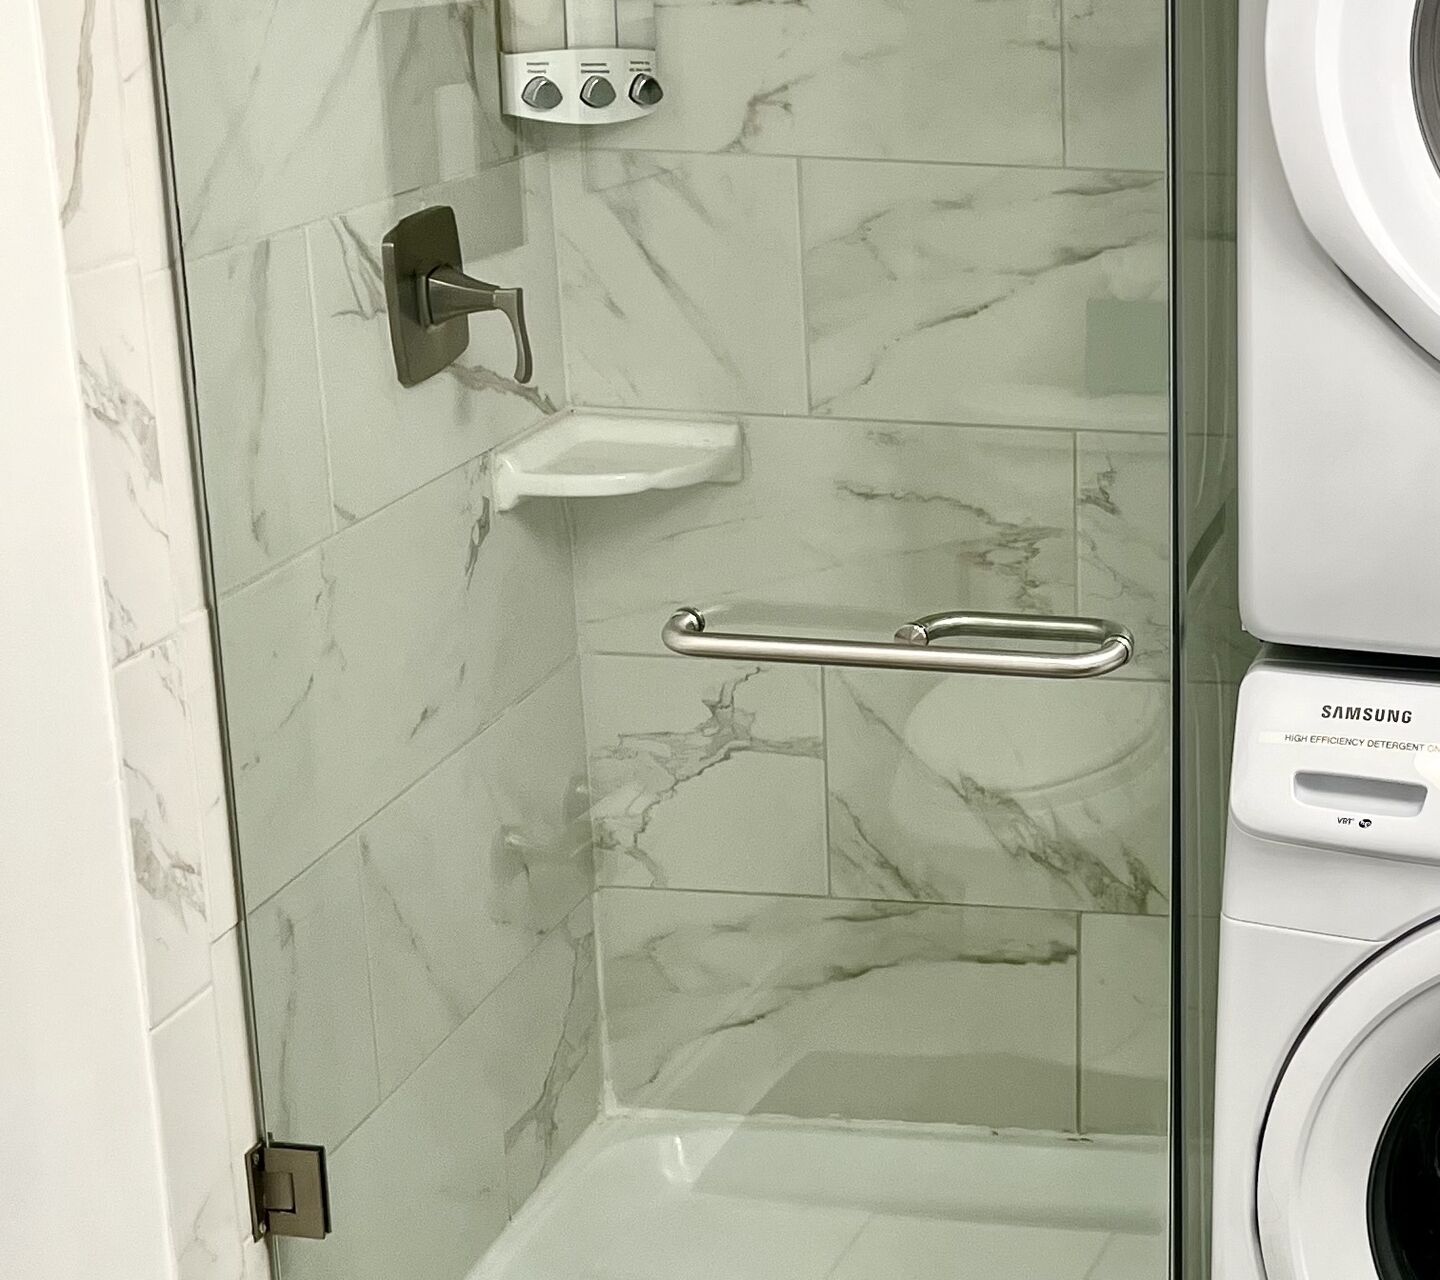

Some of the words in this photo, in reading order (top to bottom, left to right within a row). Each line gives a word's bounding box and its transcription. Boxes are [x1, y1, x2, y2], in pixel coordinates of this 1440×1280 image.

[1321, 705, 1412, 724] SAMSUNG
[1284, 733, 1308, 743] HIGH
[1310, 735, 1365, 747] EFFICIENCY
[1367, 739, 1425, 752] DETERGENT
